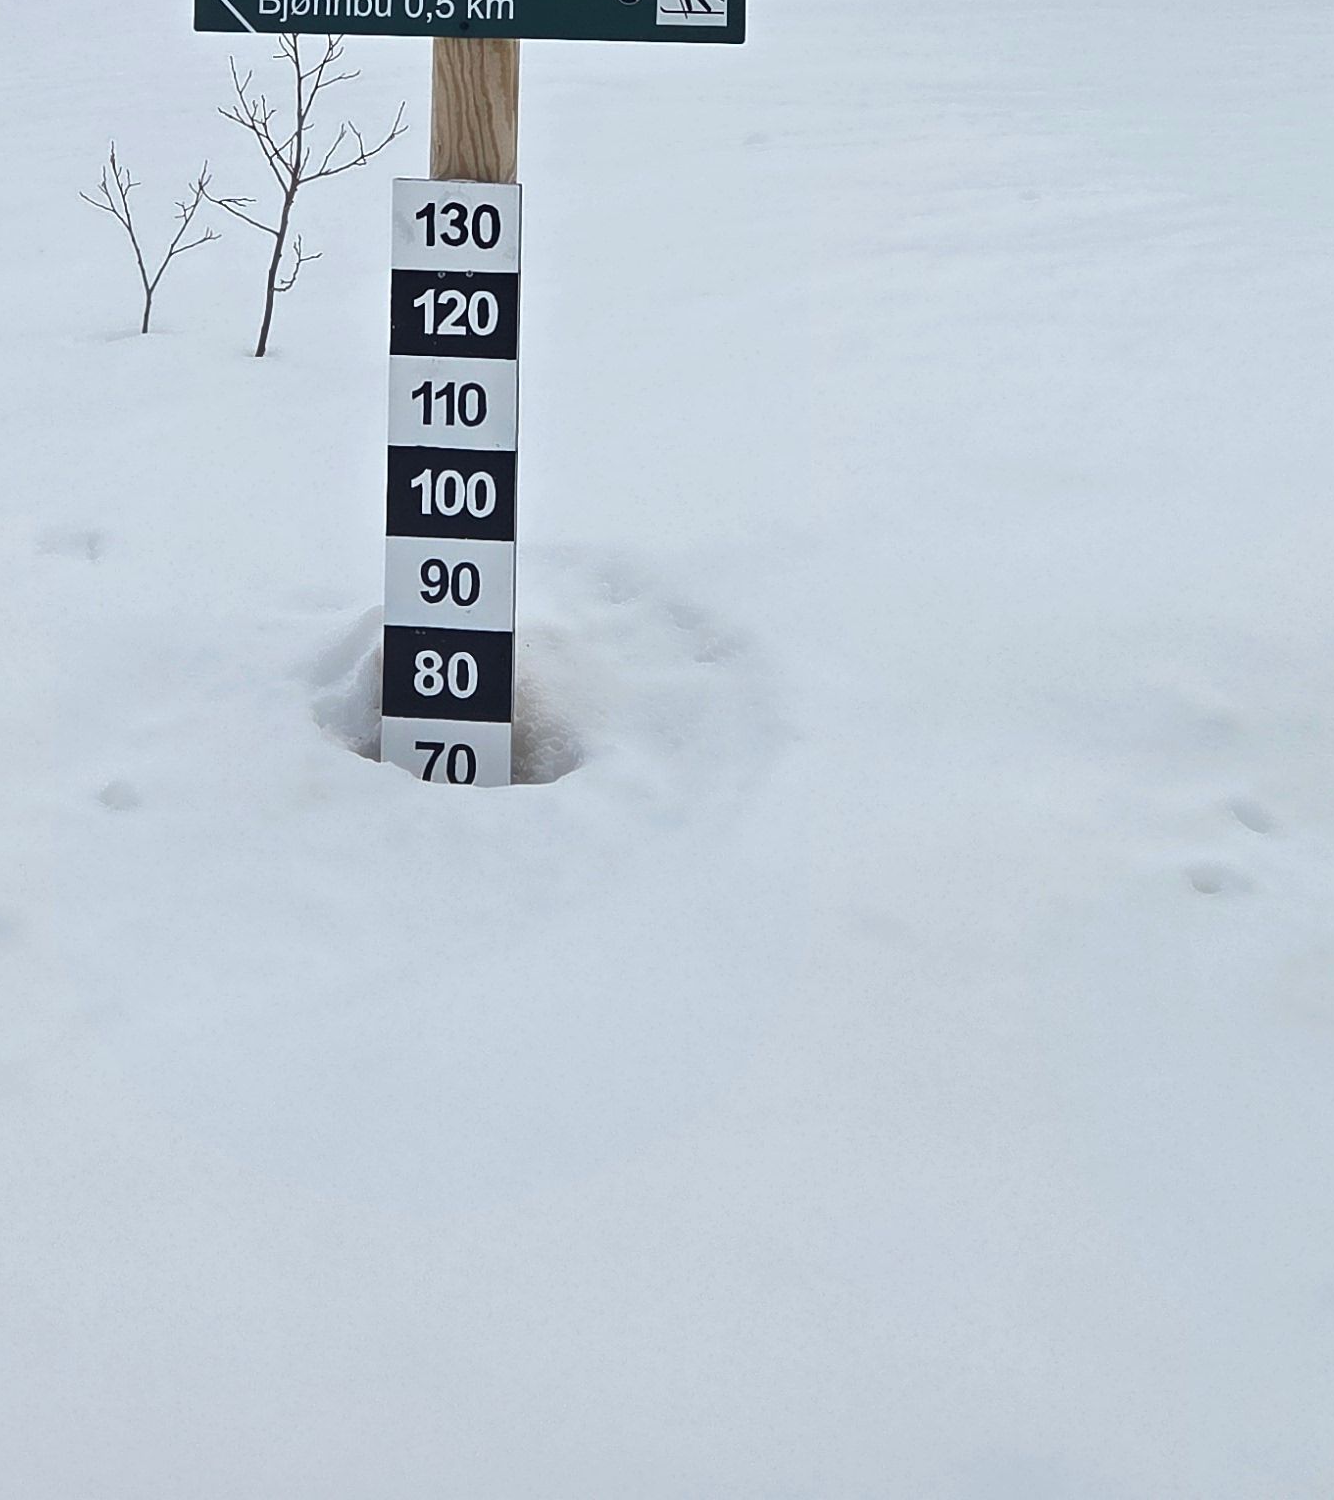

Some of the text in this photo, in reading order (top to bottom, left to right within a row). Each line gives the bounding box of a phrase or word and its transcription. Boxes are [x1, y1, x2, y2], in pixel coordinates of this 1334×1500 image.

[415, 202, 501, 250] 130
[412, 288, 499, 337] 120
[411, 380, 487, 427] 110
[410, 468, 497, 519] 100
[419, 558, 481, 607] 90
[414, 650, 478, 698] 80
[415, 741, 477, 785] 70
